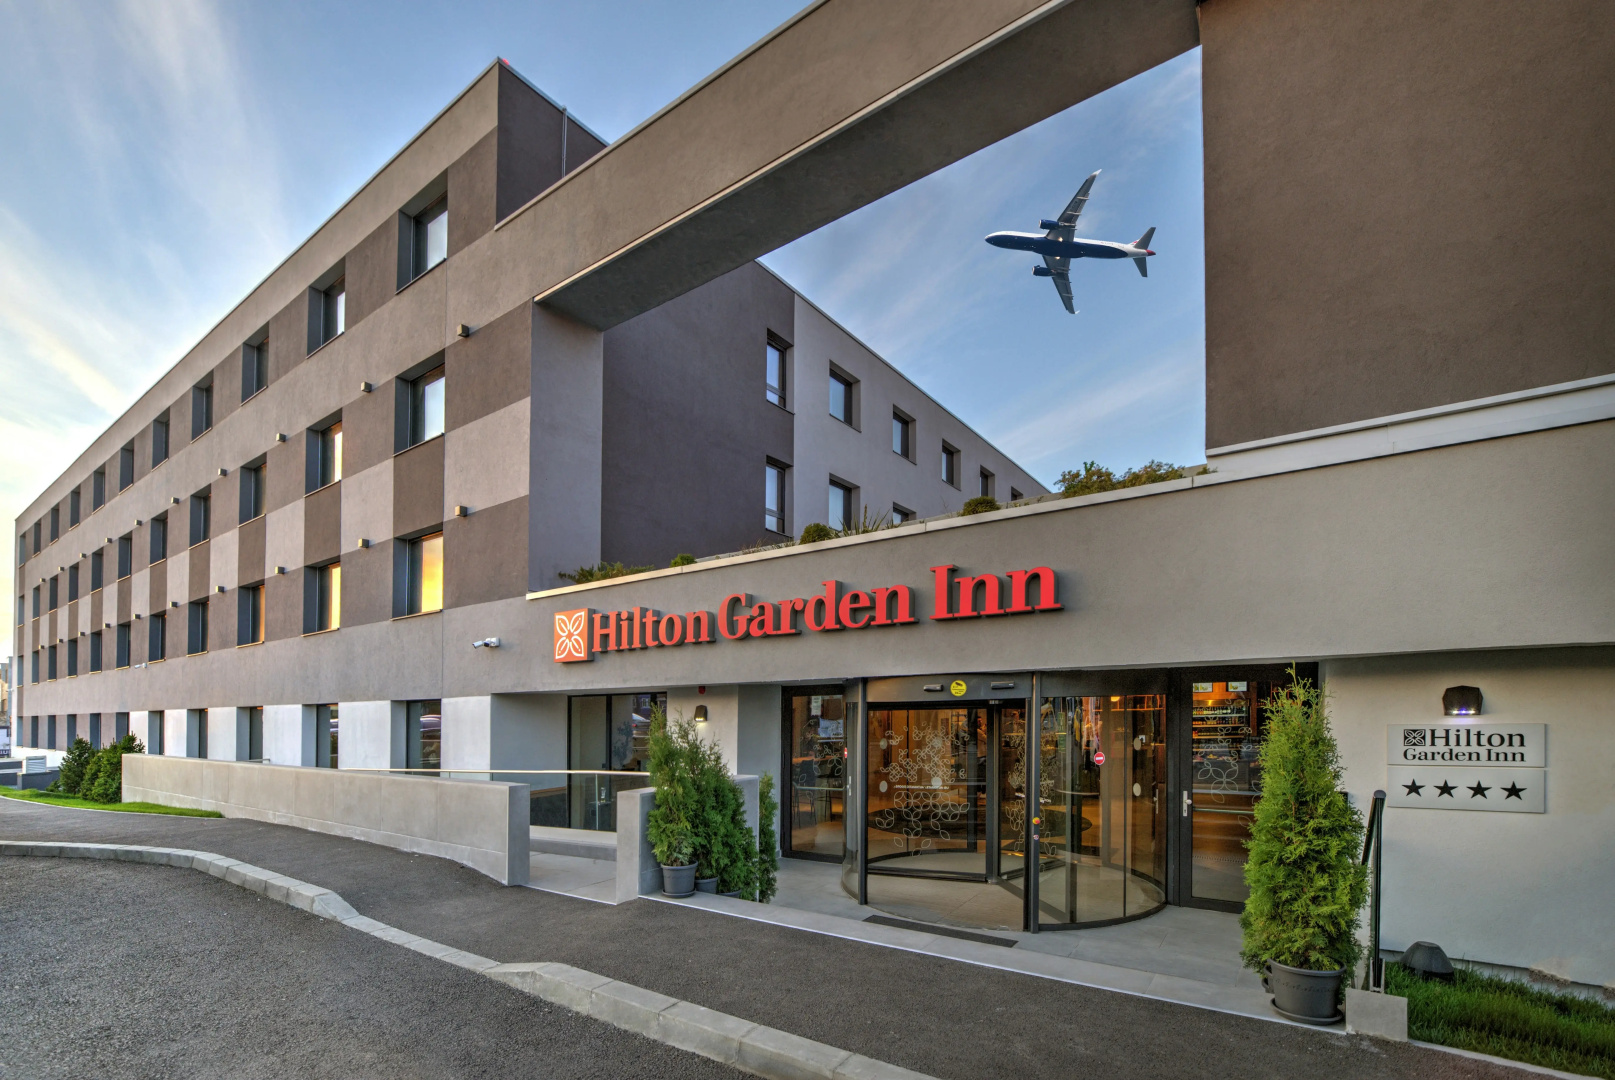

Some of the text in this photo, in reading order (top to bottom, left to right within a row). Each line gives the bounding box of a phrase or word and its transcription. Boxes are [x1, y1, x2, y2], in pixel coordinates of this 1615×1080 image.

[592, 564, 1063, 652] Hilton Garden Inn
[1429, 728, 1526, 748] Hilton
[1403, 748, 1527, 762] Garden Inn
